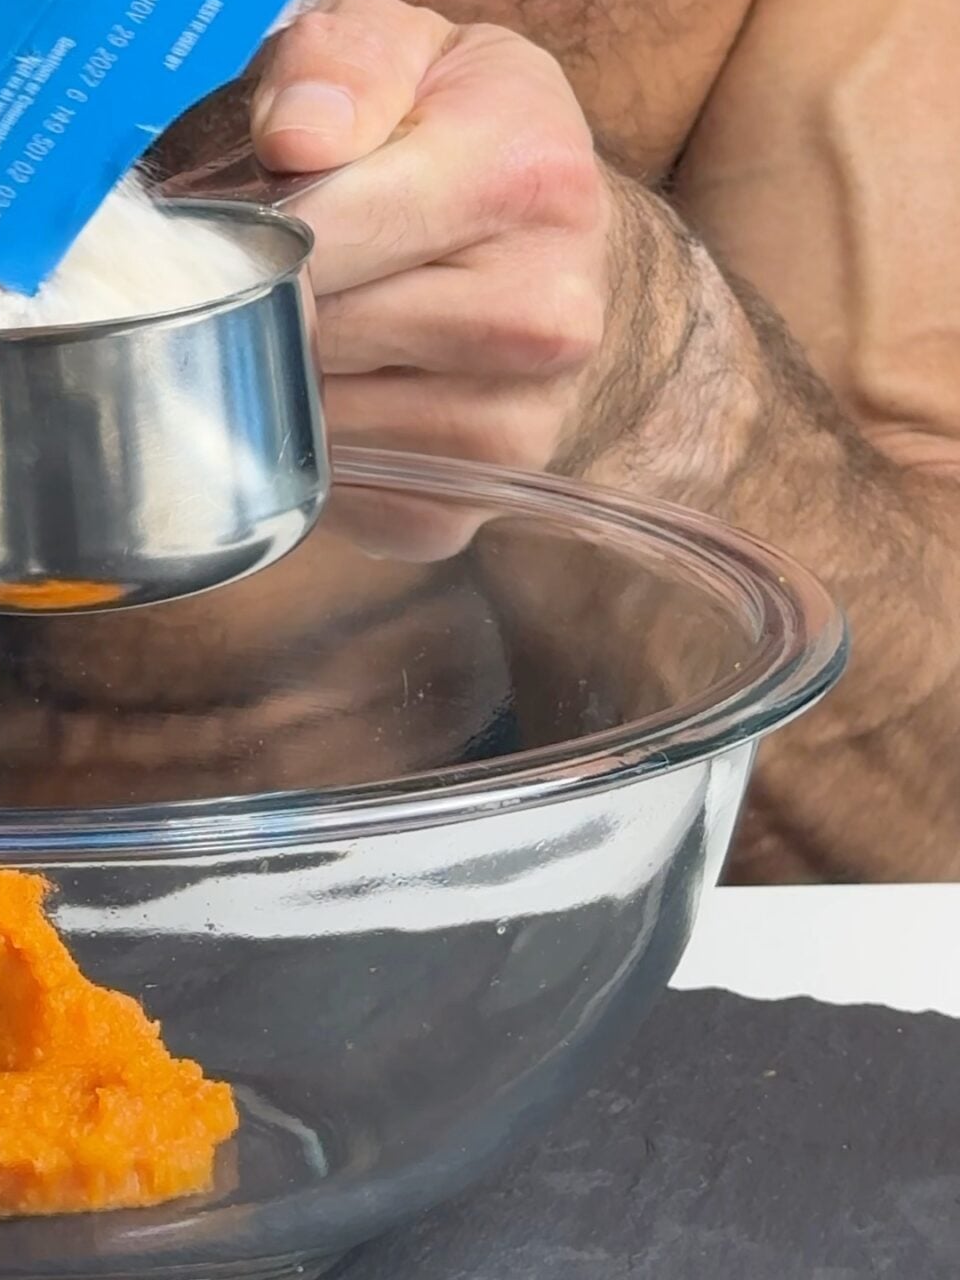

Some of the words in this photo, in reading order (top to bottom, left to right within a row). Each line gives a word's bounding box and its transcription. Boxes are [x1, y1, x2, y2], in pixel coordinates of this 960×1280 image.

[105, 23, 134, 49] 29
[31, 36, 77, 84] Questions
[77, 47, 118, 89] 2027
[23, 80, 39, 95] or
[64, 87, 88, 105] 6
[41, 102, 76, 135] 149
[5, 158, 35, 185] 02
